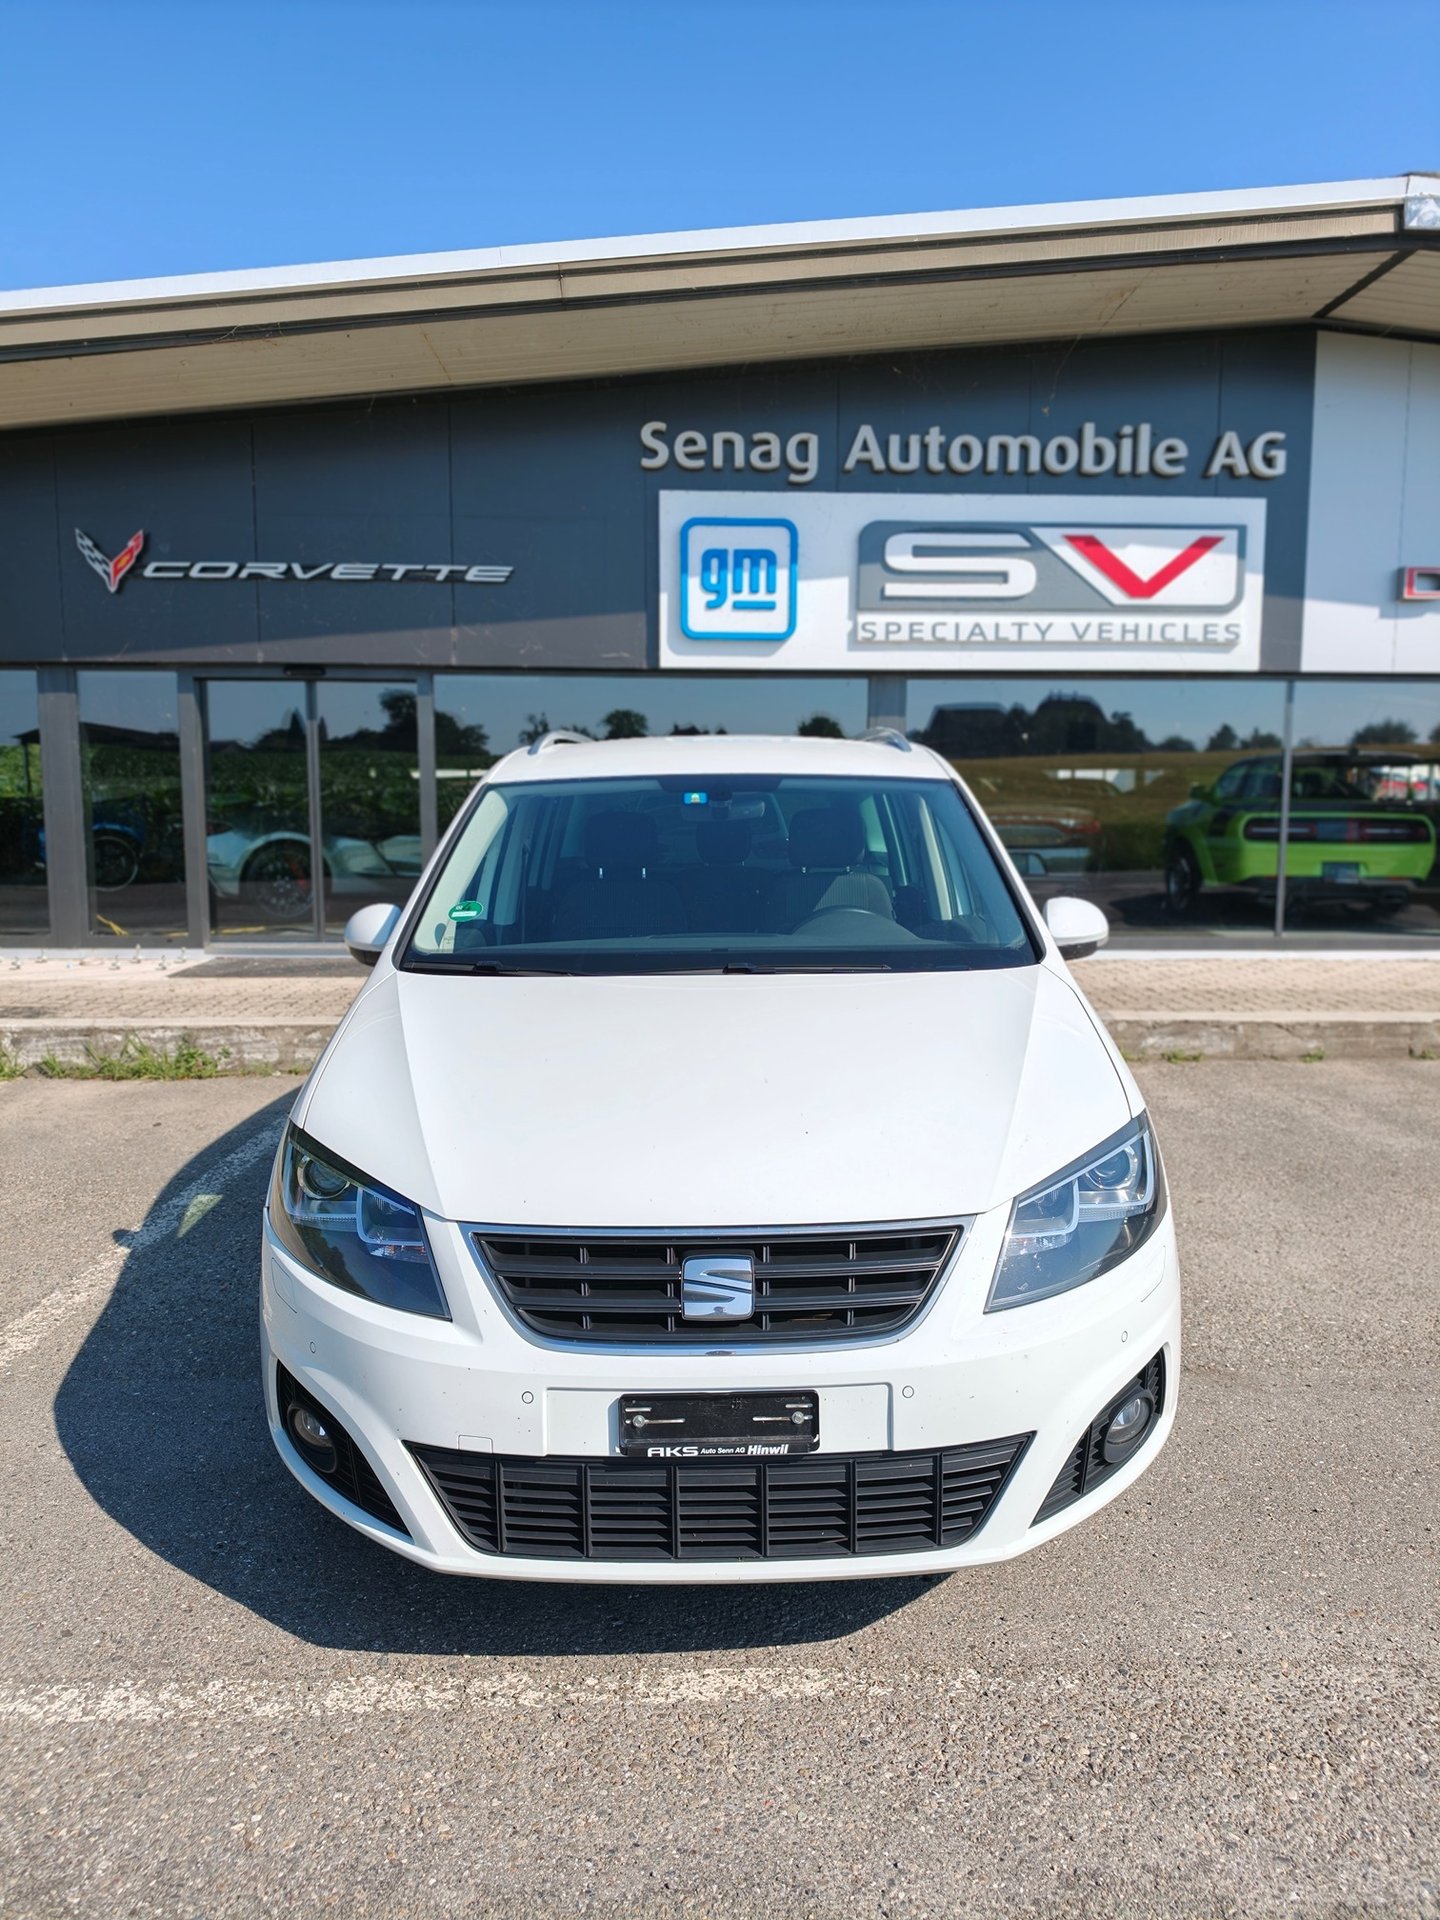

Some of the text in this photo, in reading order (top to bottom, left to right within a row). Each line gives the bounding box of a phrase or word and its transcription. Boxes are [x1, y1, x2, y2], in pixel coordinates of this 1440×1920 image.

[639, 421, 1288, 484] Senag Automobile AG
[142, 561, 515, 582] CORVETTE
[700, 547, 778, 611] gm
[859, 621, 1243, 644] SPECIALTY VEHICLES
[647, 1446, 699, 1457] AKS
[700, 1447, 716, 1455] Auto
[735, 1446, 746, 1454] AG
[747, 1444, 789, 1455] Hinwil
